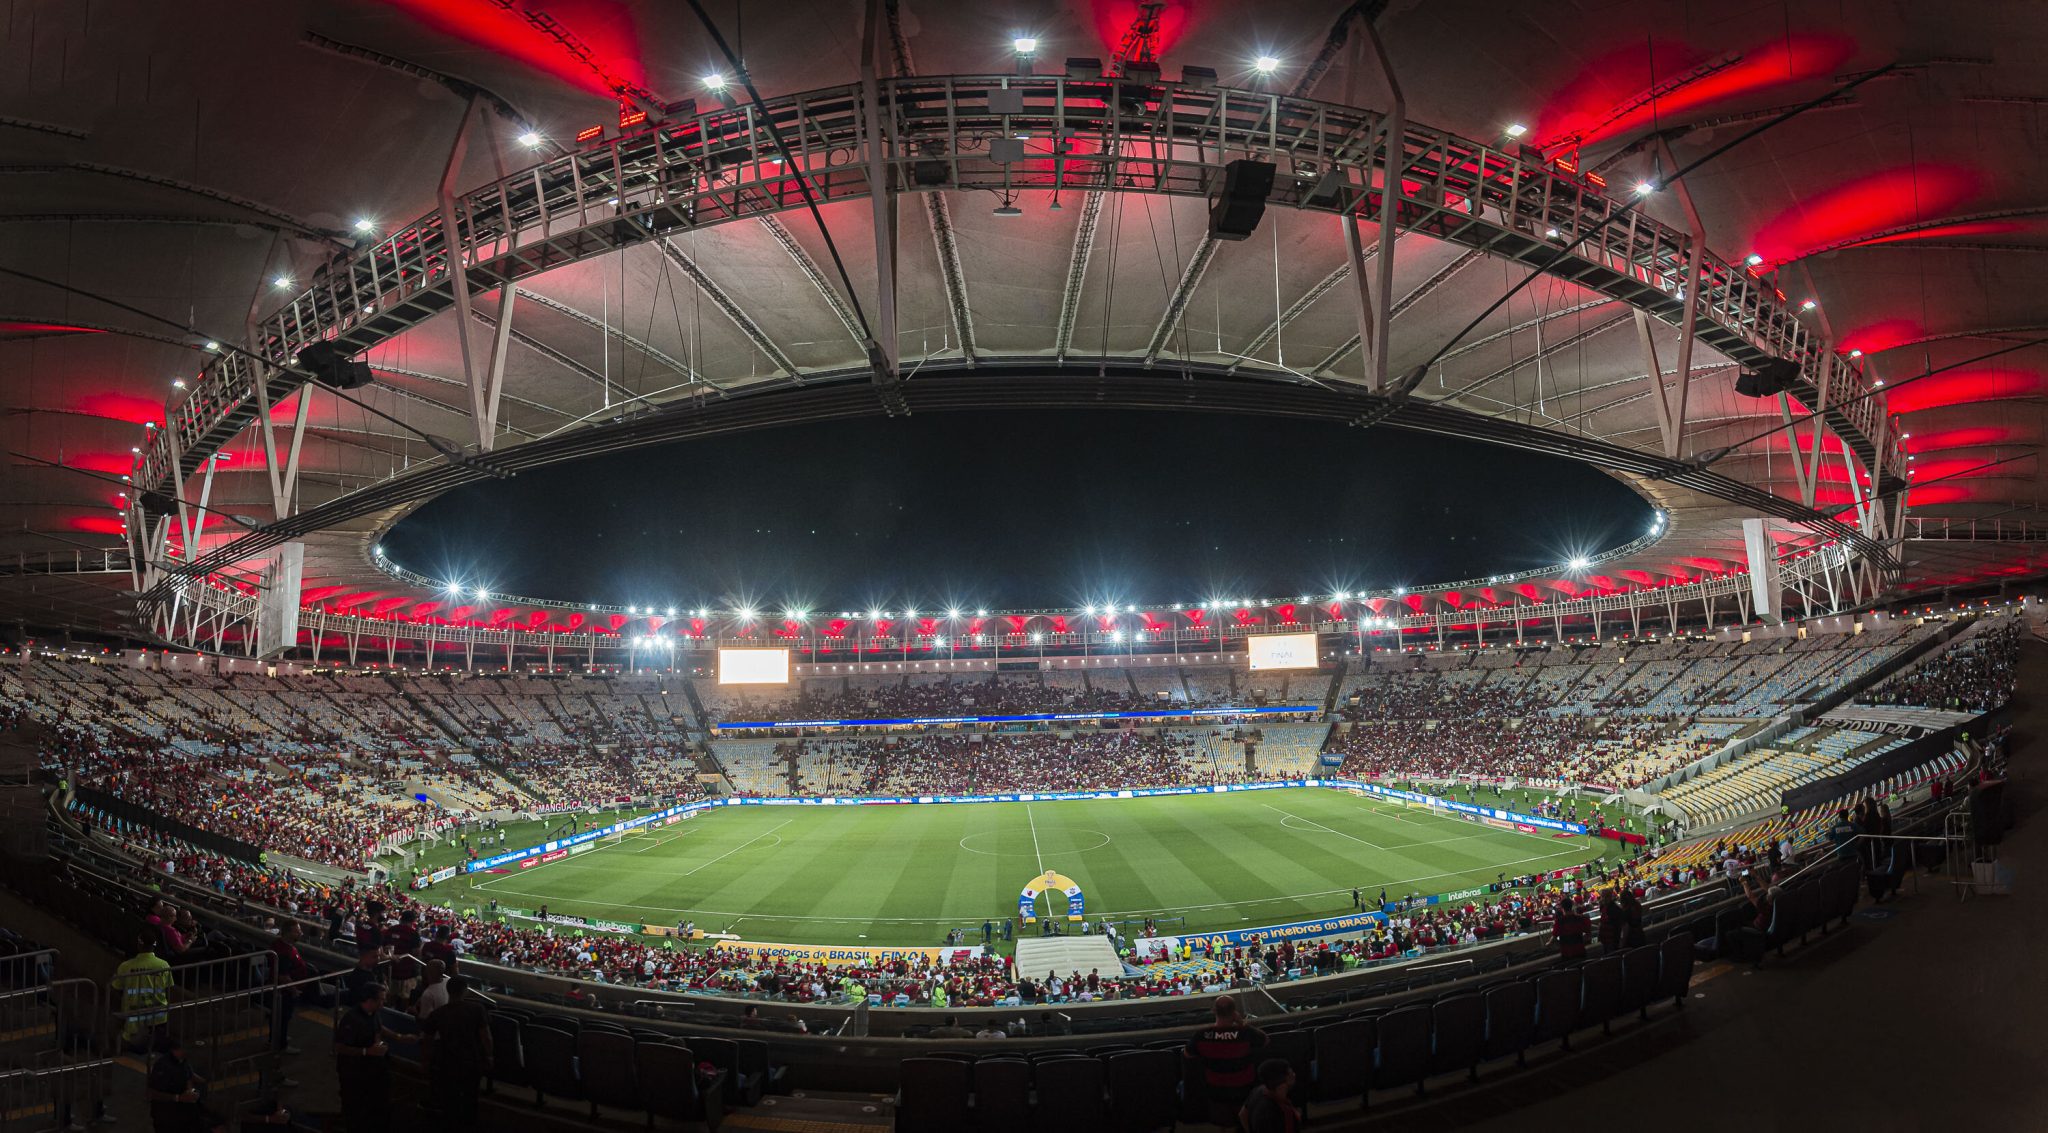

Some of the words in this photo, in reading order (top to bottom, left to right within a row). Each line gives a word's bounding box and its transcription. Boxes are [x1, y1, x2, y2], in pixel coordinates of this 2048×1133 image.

[1448, 889, 1482, 901] Intelbras
[596, 920, 633, 931] Intelbras
[1185, 934, 1234, 949] FINAL
[1270, 923, 1323, 938] Intelbras
[1324, 920, 1338, 931] do
[1339, 915, 1375, 928] BRASIL
[829, 950, 869, 960] BRASIL
[1214, 1031, 1239, 1040] MRV
